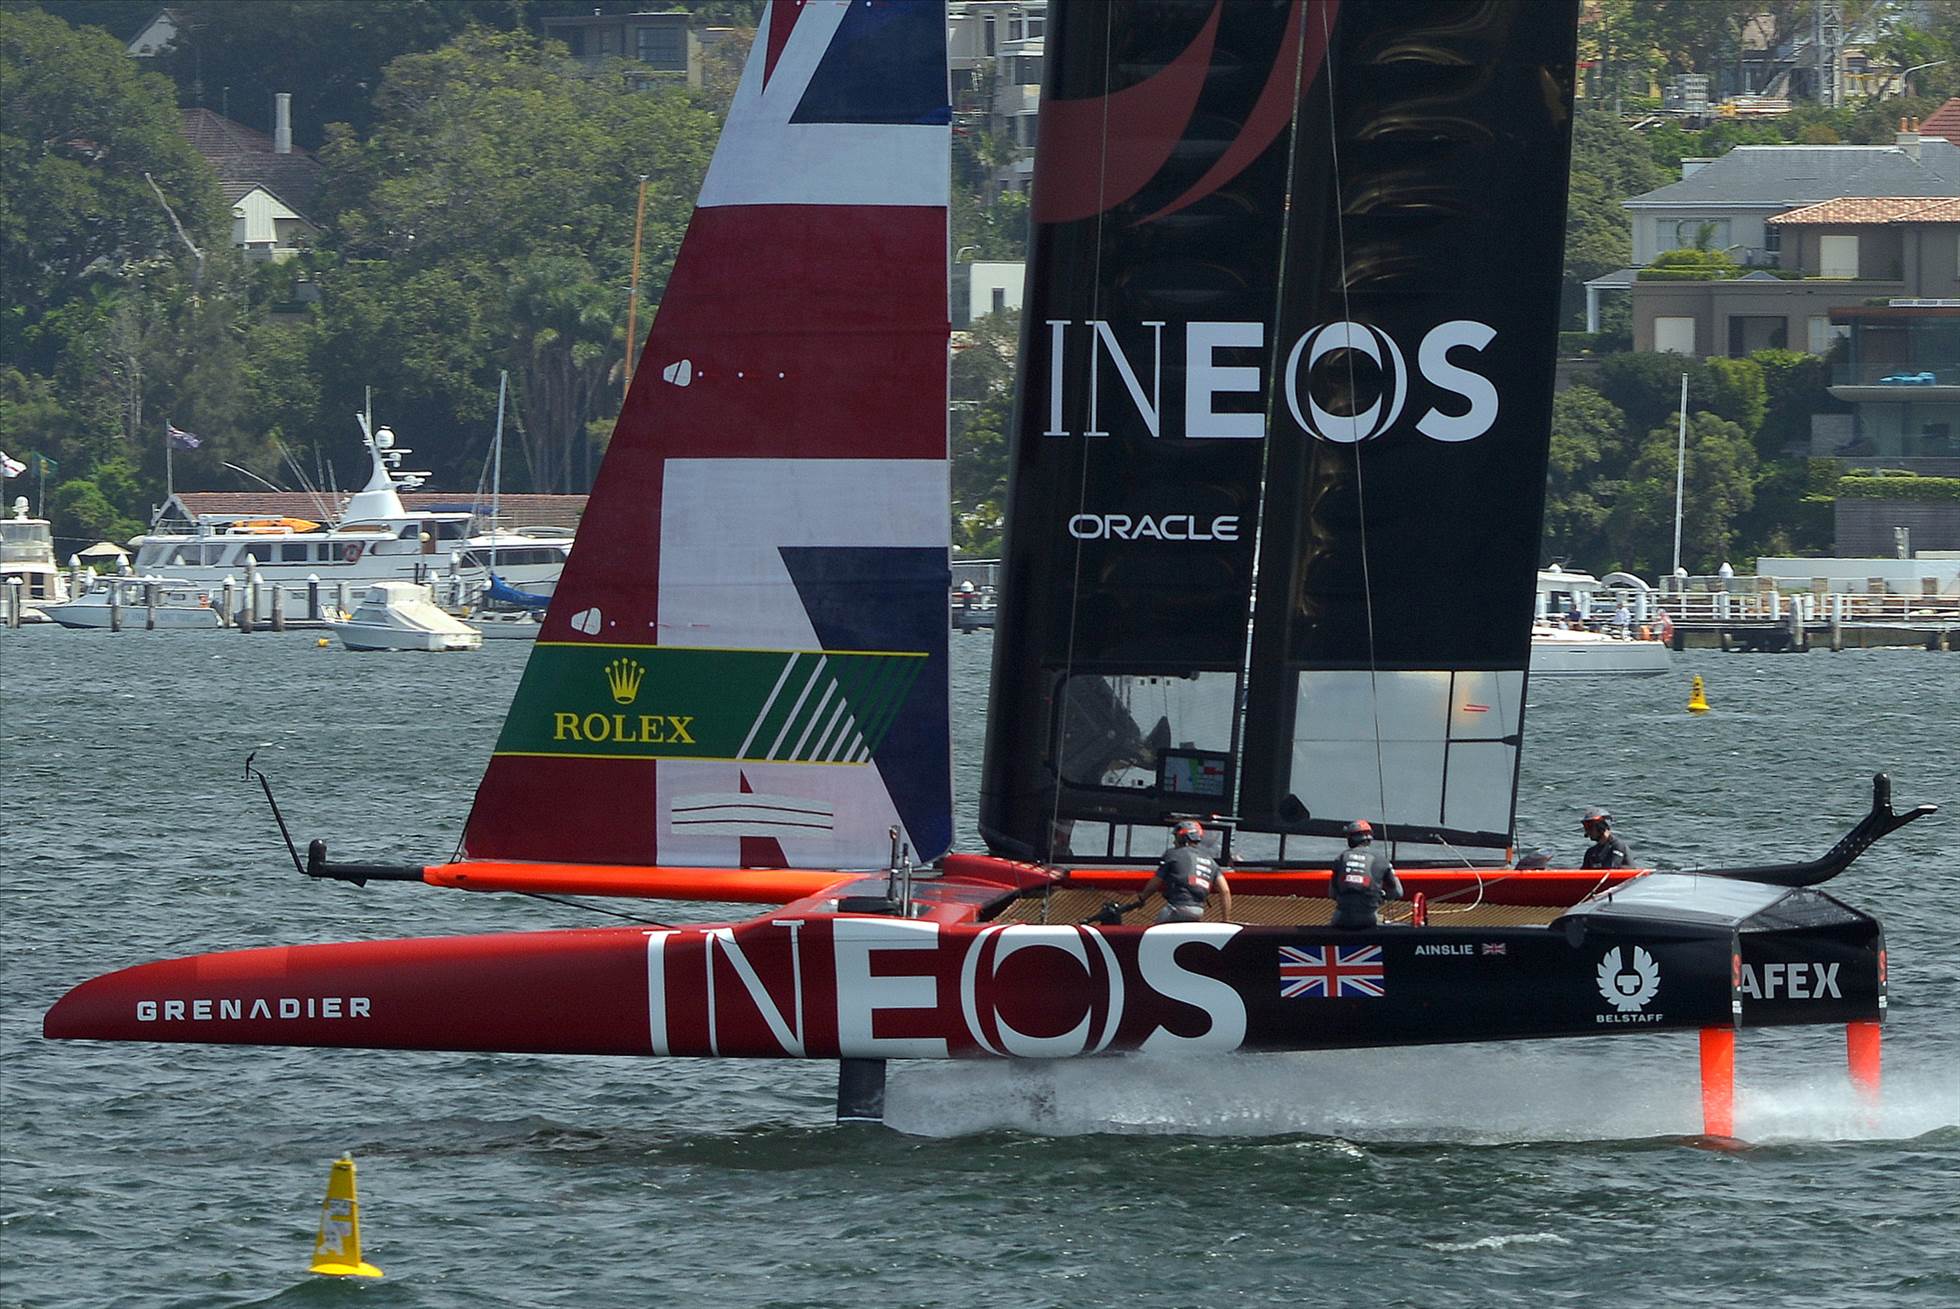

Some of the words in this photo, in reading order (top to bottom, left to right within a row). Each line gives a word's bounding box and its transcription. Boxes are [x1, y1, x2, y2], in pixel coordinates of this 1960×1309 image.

[1042, 319, 1499, 443] INEOS
[1068, 513, 1240, 541] ORACLE
[553, 712, 696, 743] ROLEX
[1415, 944, 1474, 956] AINSLIE
[643, 918, 1247, 1058] INEOS
[1739, 962, 1842, 999] AFEX
[136, 997, 371, 1022] GRENADIER
[1596, 1013, 1663, 1023] BELSTAFF
